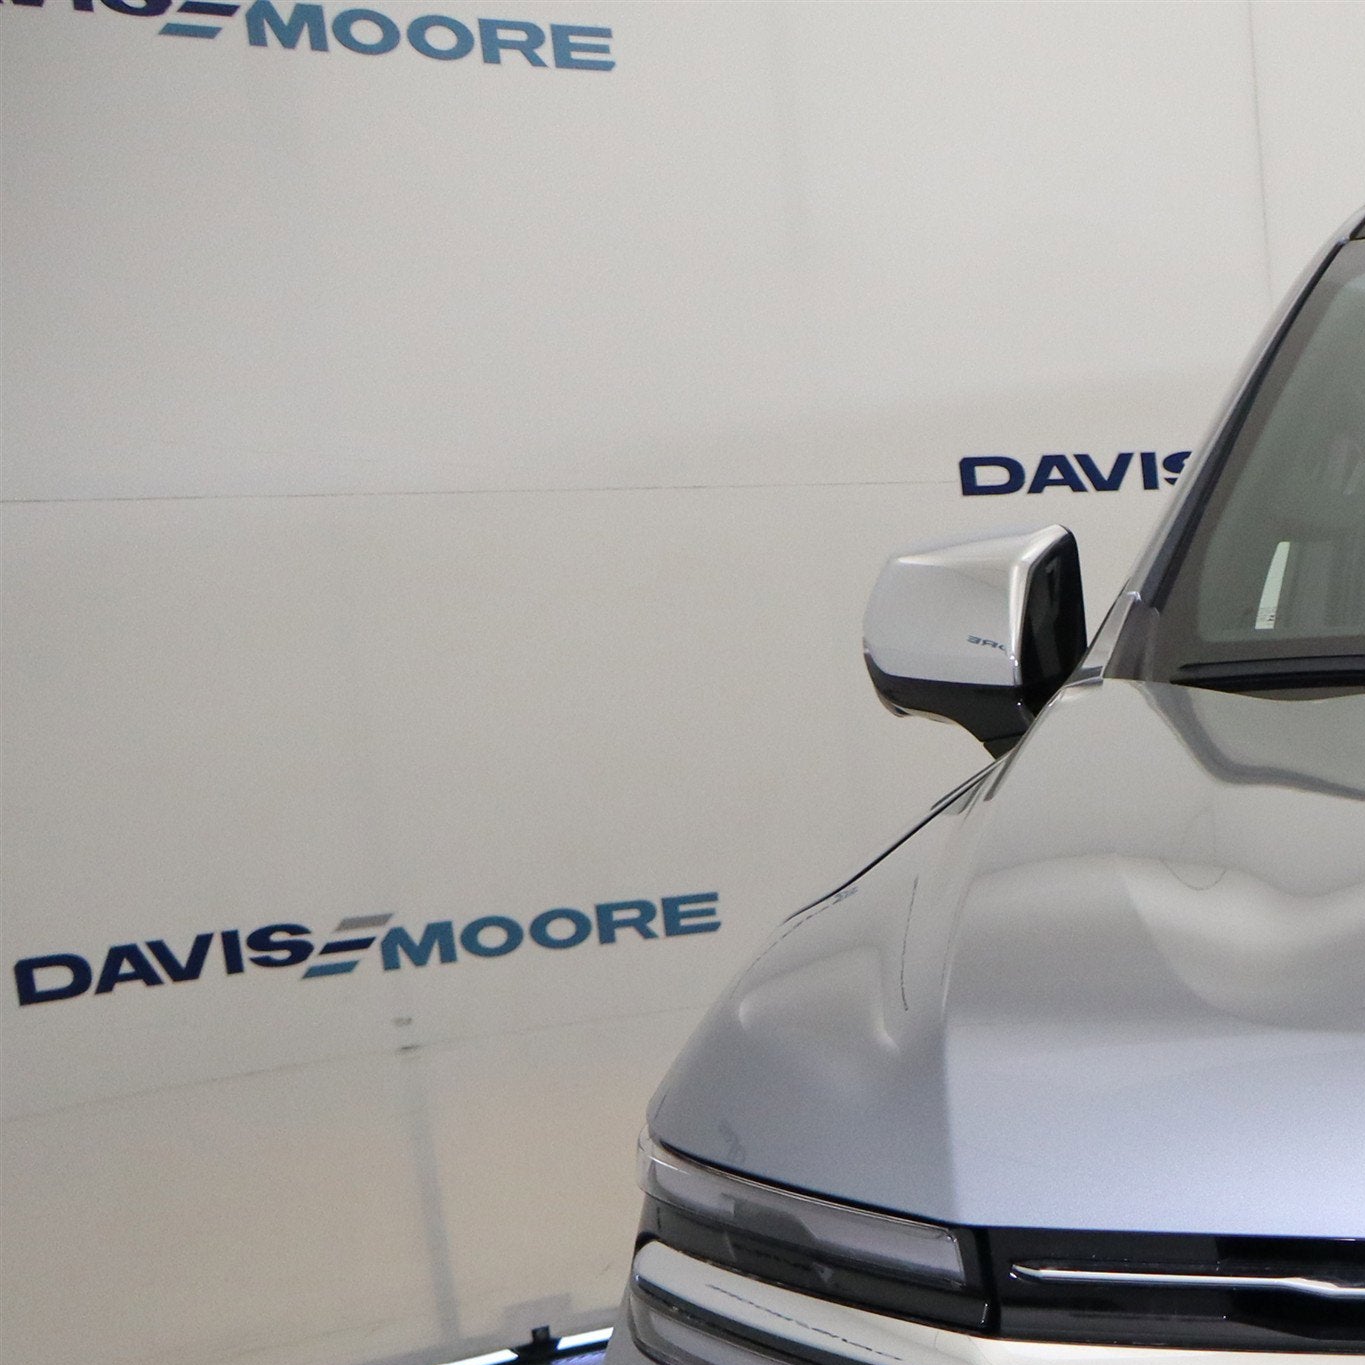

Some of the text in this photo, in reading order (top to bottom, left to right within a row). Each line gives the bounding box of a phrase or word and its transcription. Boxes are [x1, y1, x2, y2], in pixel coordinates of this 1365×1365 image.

[245, 3, 617, 72] MOORE
[12, 891, 723, 1007] DAVIS MOORE
